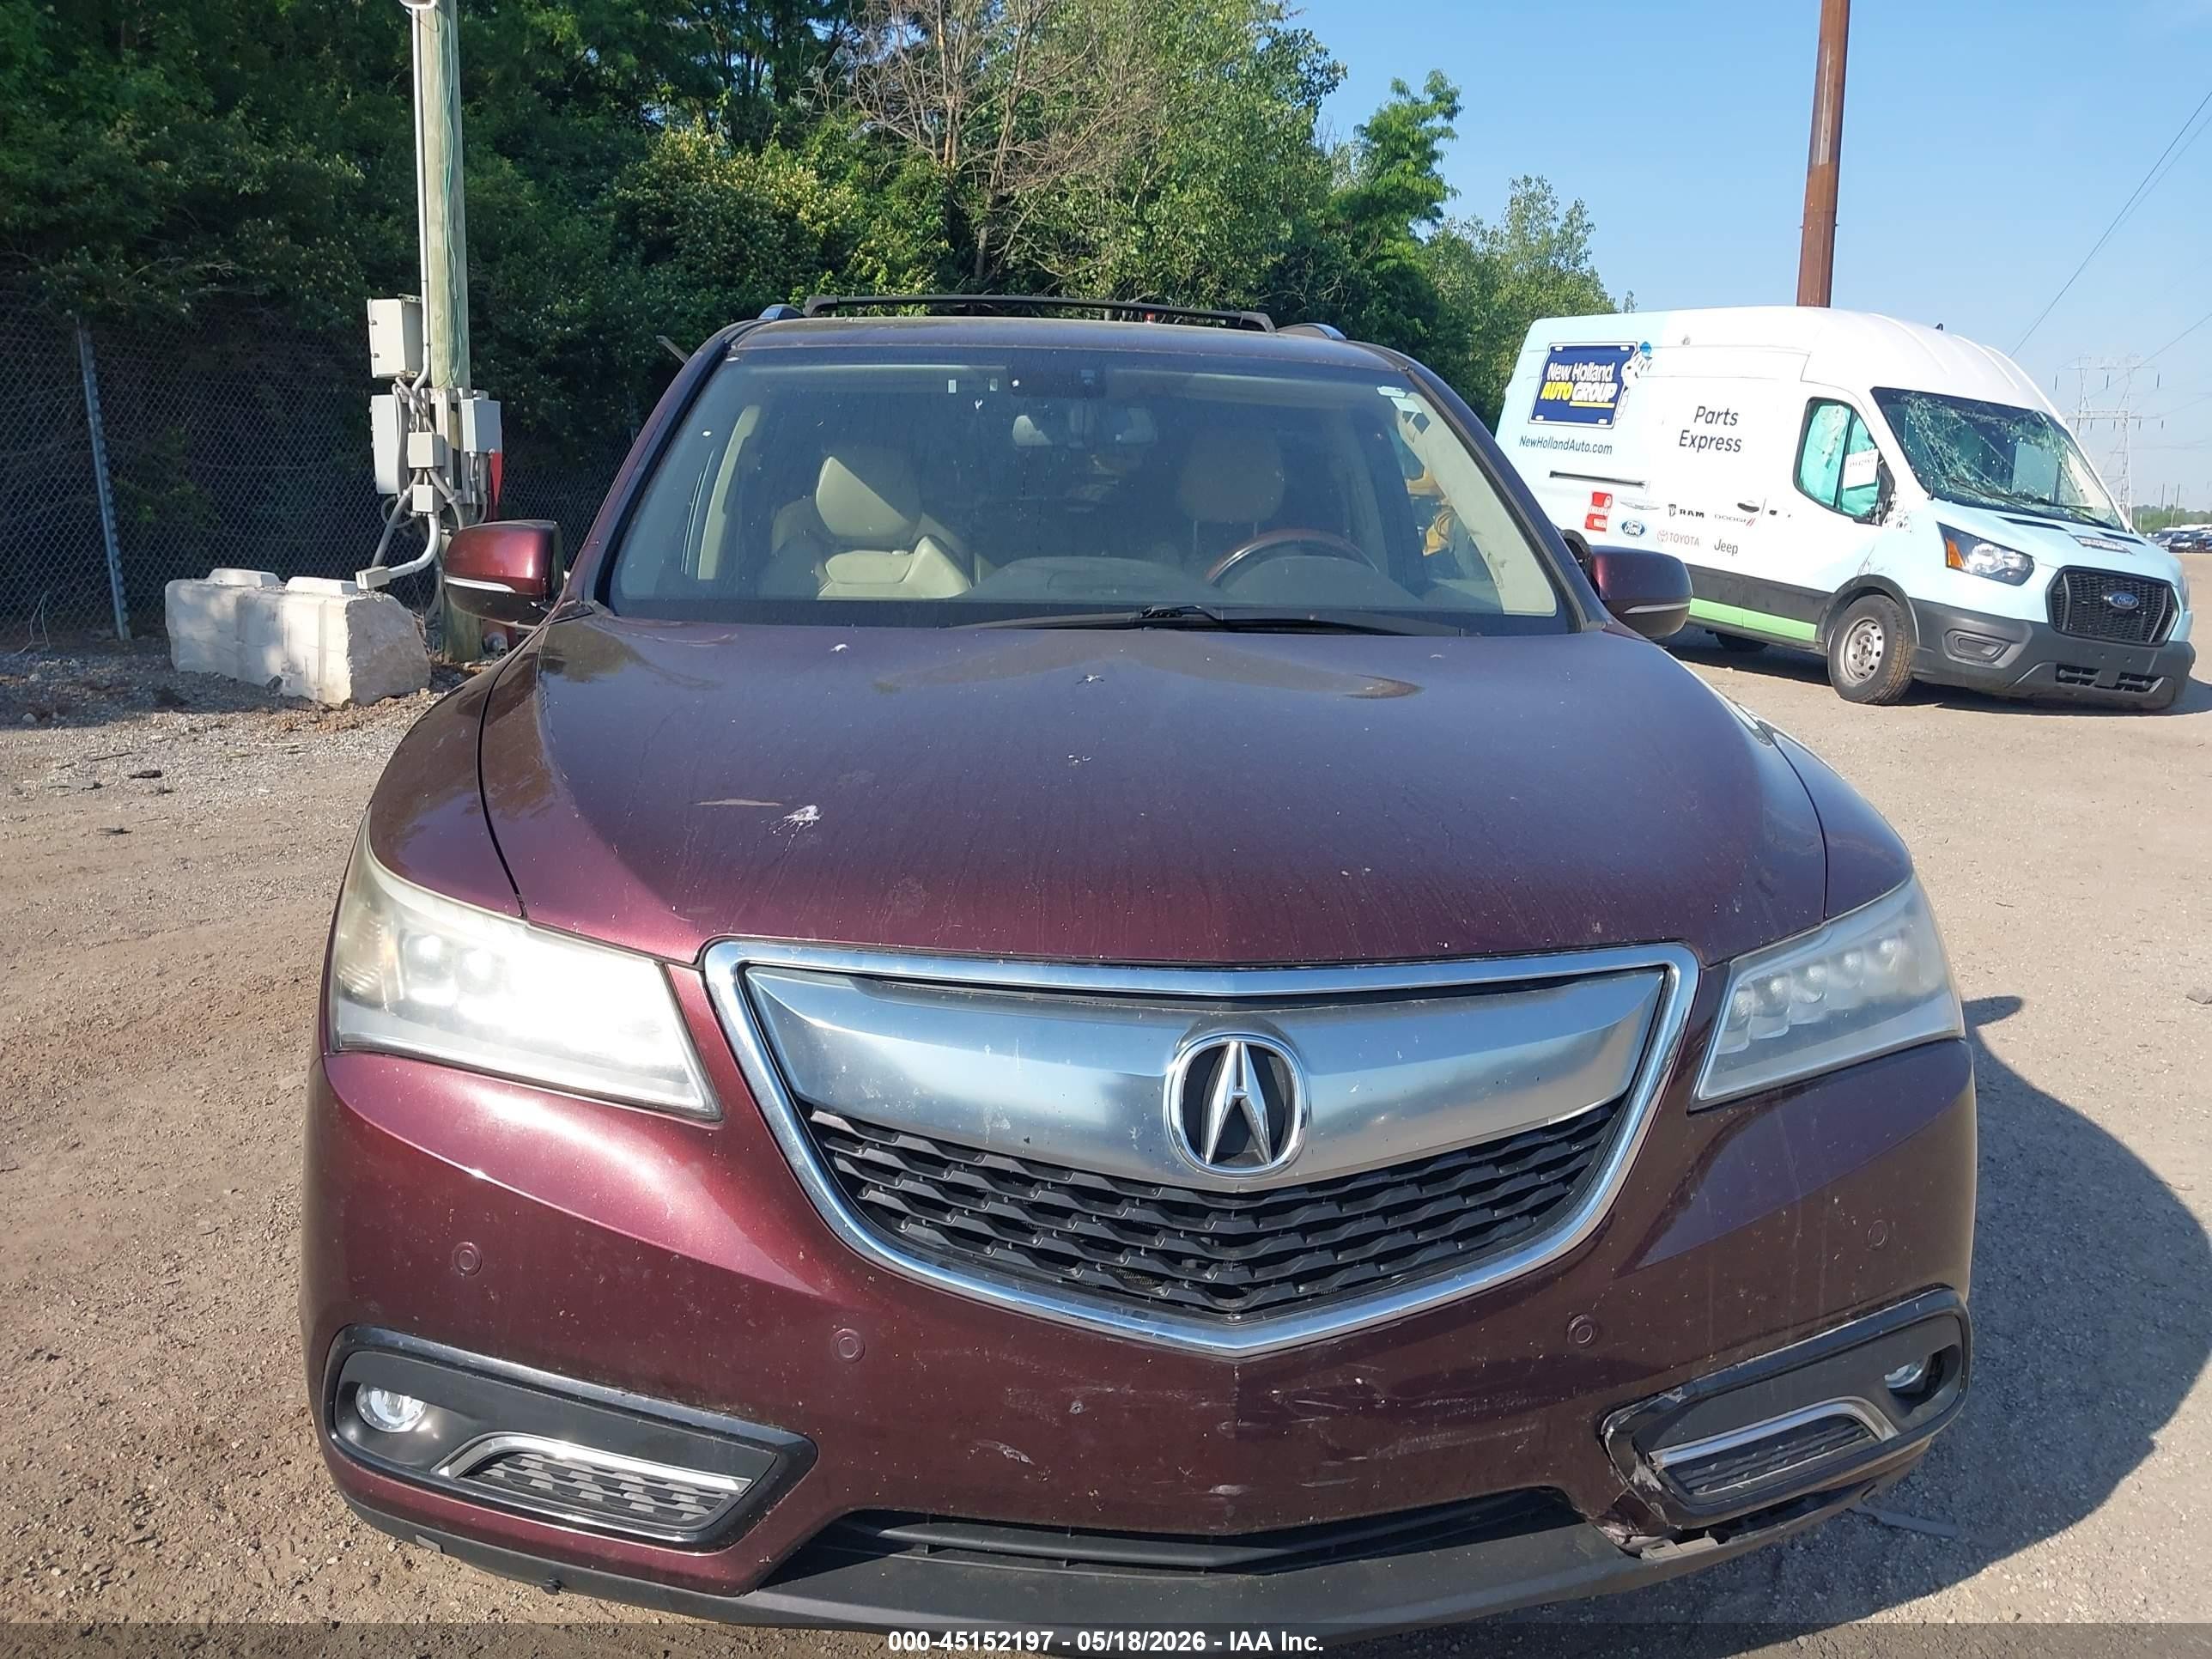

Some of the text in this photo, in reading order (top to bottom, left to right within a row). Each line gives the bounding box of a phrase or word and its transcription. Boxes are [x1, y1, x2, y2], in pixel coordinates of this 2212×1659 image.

[1547, 362, 1616, 382] New Holland
[1540, 381, 1619, 402] AUTO GROUP
[1693, 404, 1739, 426] Parts
[1518, 435, 1613, 455] NewHollandAuto.com
[1679, 429, 1742, 453] Express
[1680, 508, 1705, 519] RAM
[1669, 532, 1699, 547] TOYOTA
[1714, 538, 1738, 556] Jeep
